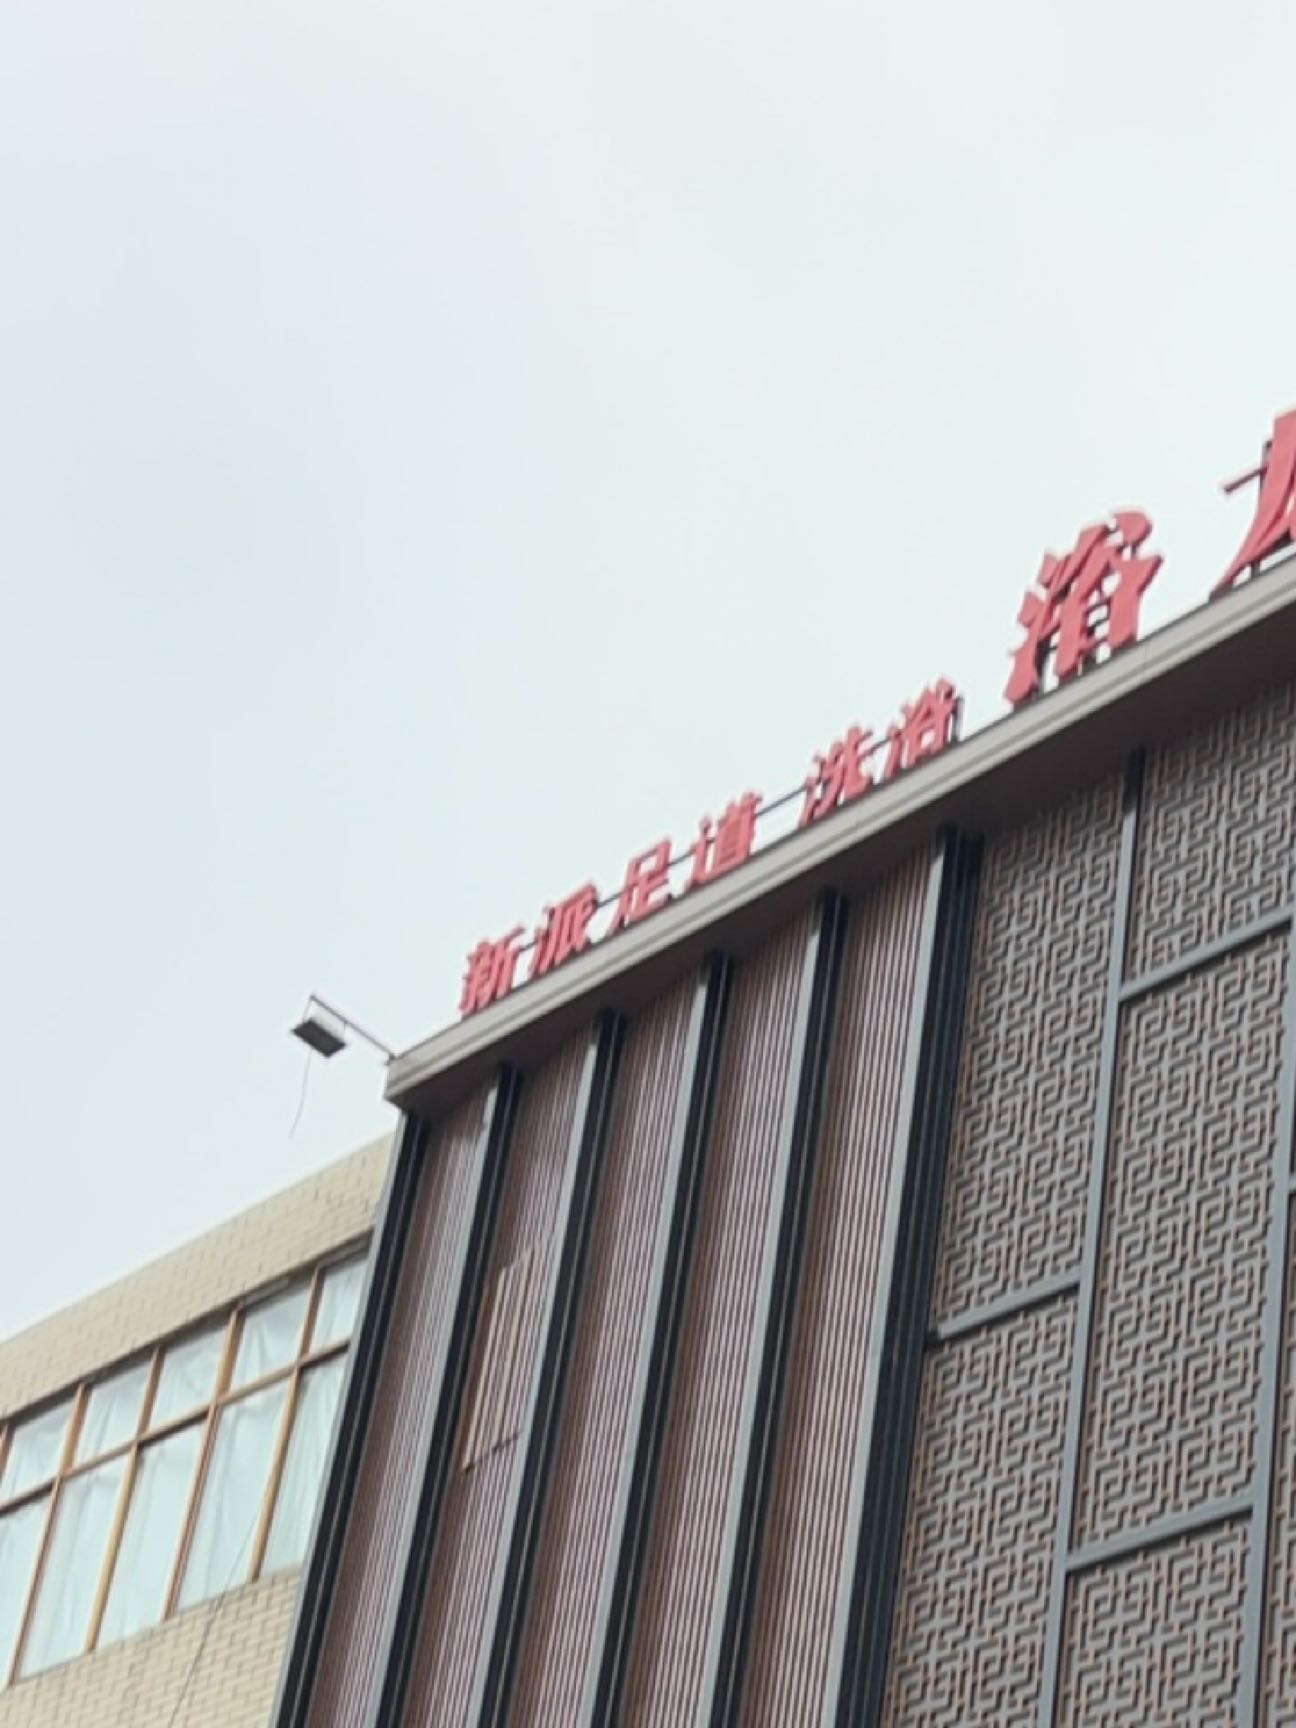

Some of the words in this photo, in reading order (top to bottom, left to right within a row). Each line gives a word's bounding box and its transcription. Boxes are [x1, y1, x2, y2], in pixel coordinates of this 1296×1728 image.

[459, 791, 763, 1019] 新派足道
[799, 675, 958, 827] 洗浴
